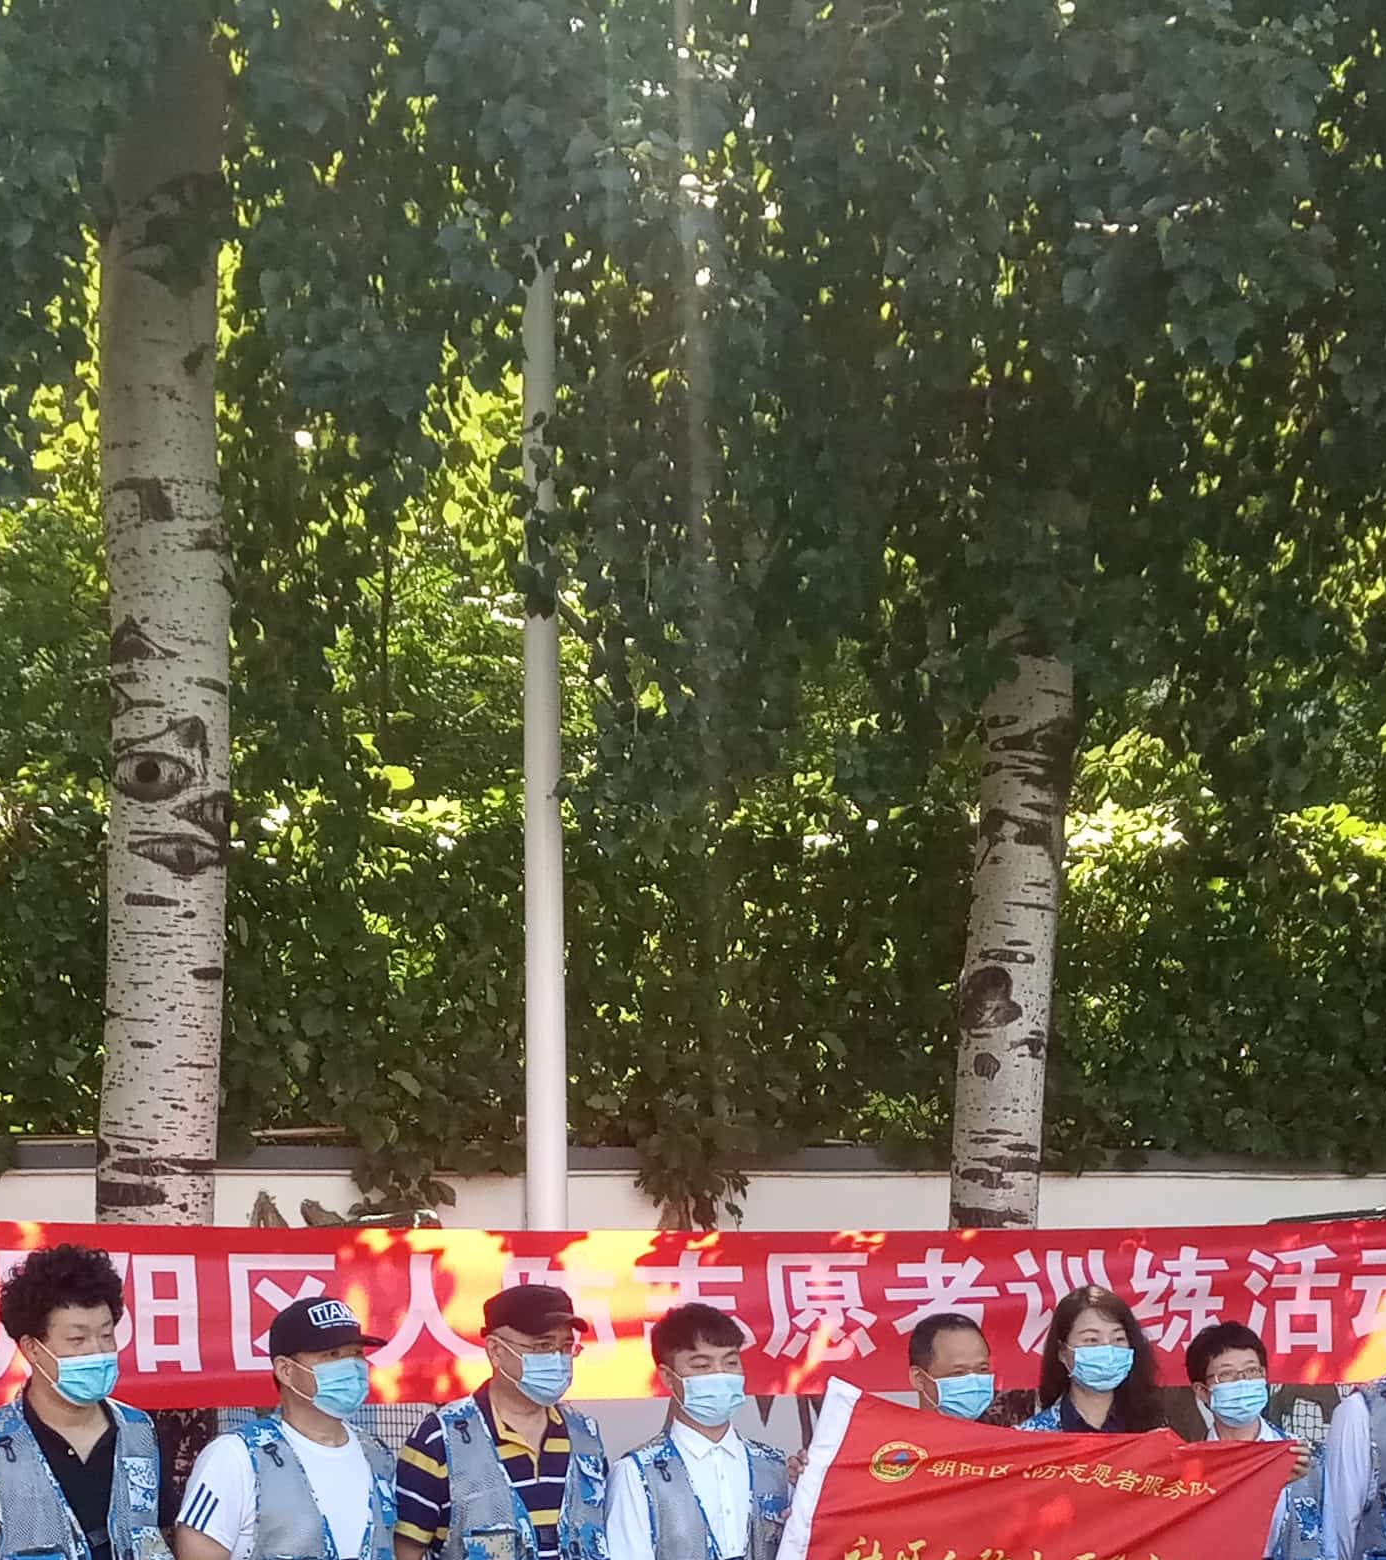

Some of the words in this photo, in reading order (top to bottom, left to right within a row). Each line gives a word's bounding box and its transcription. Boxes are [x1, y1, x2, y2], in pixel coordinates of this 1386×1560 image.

[927, 1460, 1217, 1499] 朝阳区防志愿者服务队
